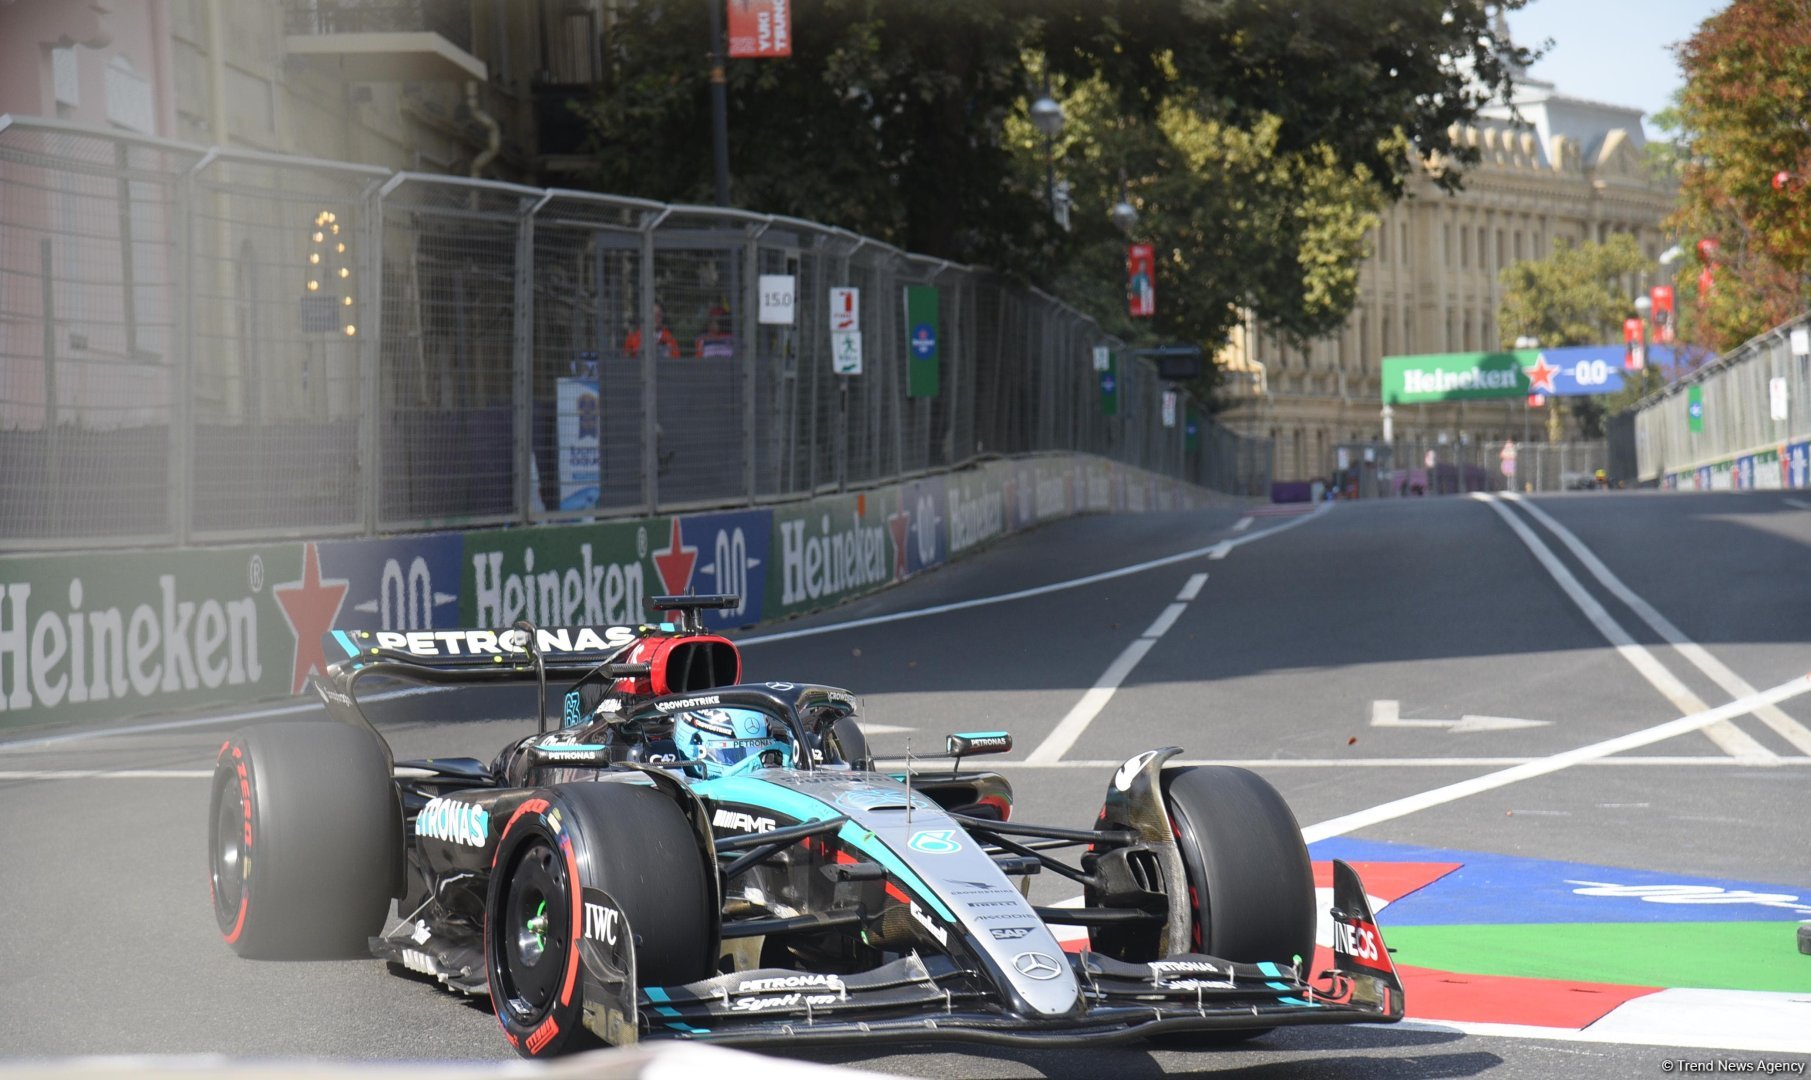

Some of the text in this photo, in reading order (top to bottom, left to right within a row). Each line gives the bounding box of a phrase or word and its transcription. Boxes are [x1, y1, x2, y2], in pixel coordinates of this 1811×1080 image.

[758, 11, 770, 51] YUKI
[1404, 366, 1516, 394] Heineken
[781, 510, 887, 606] Heineken
[473, 541, 646, 628] Heineken
[0, 575, 262, 711] Heineken
[658, 695, 720, 711] CROWDSTRIKE
[548, 751, 596, 760] PETRONAS
[970, 737, 1006, 746] PETRONAS
[732, 812, 776, 834] AMG
[584, 902, 618, 946] IWC
[993, 928, 1027, 939] SAP
[1333, 920, 1378, 961] INEOS
[739, 974, 839, 992] PETRONAS
